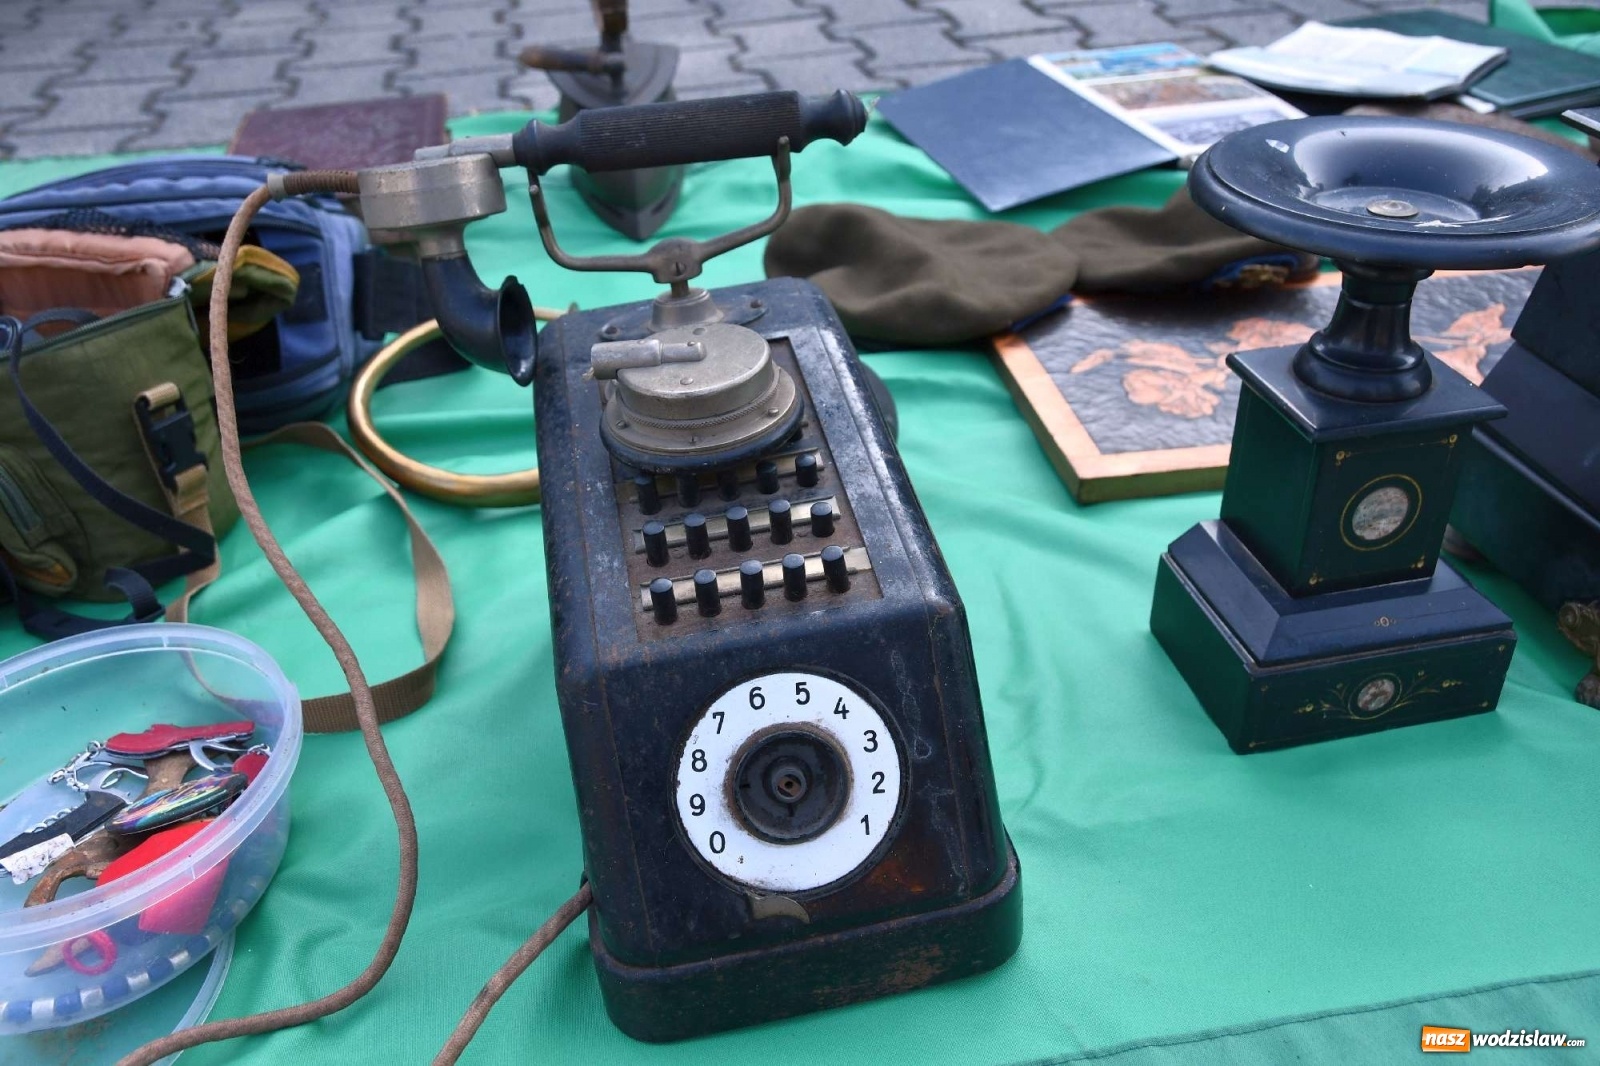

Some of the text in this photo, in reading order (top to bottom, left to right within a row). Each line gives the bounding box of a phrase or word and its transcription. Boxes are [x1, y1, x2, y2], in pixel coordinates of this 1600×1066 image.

[749, 687, 765, 710] 6
[796, 682, 810, 705] 5
[834, 697, 849, 719] 4
[712, 711, 725, 734] 7
[863, 730, 878, 752] 3
[691, 749, 707, 772] 8
[871, 771, 885, 794] 2
[690, 794, 705, 816] 9
[860, 814, 870, 835] 1
[709, 831, 725, 854] 0
